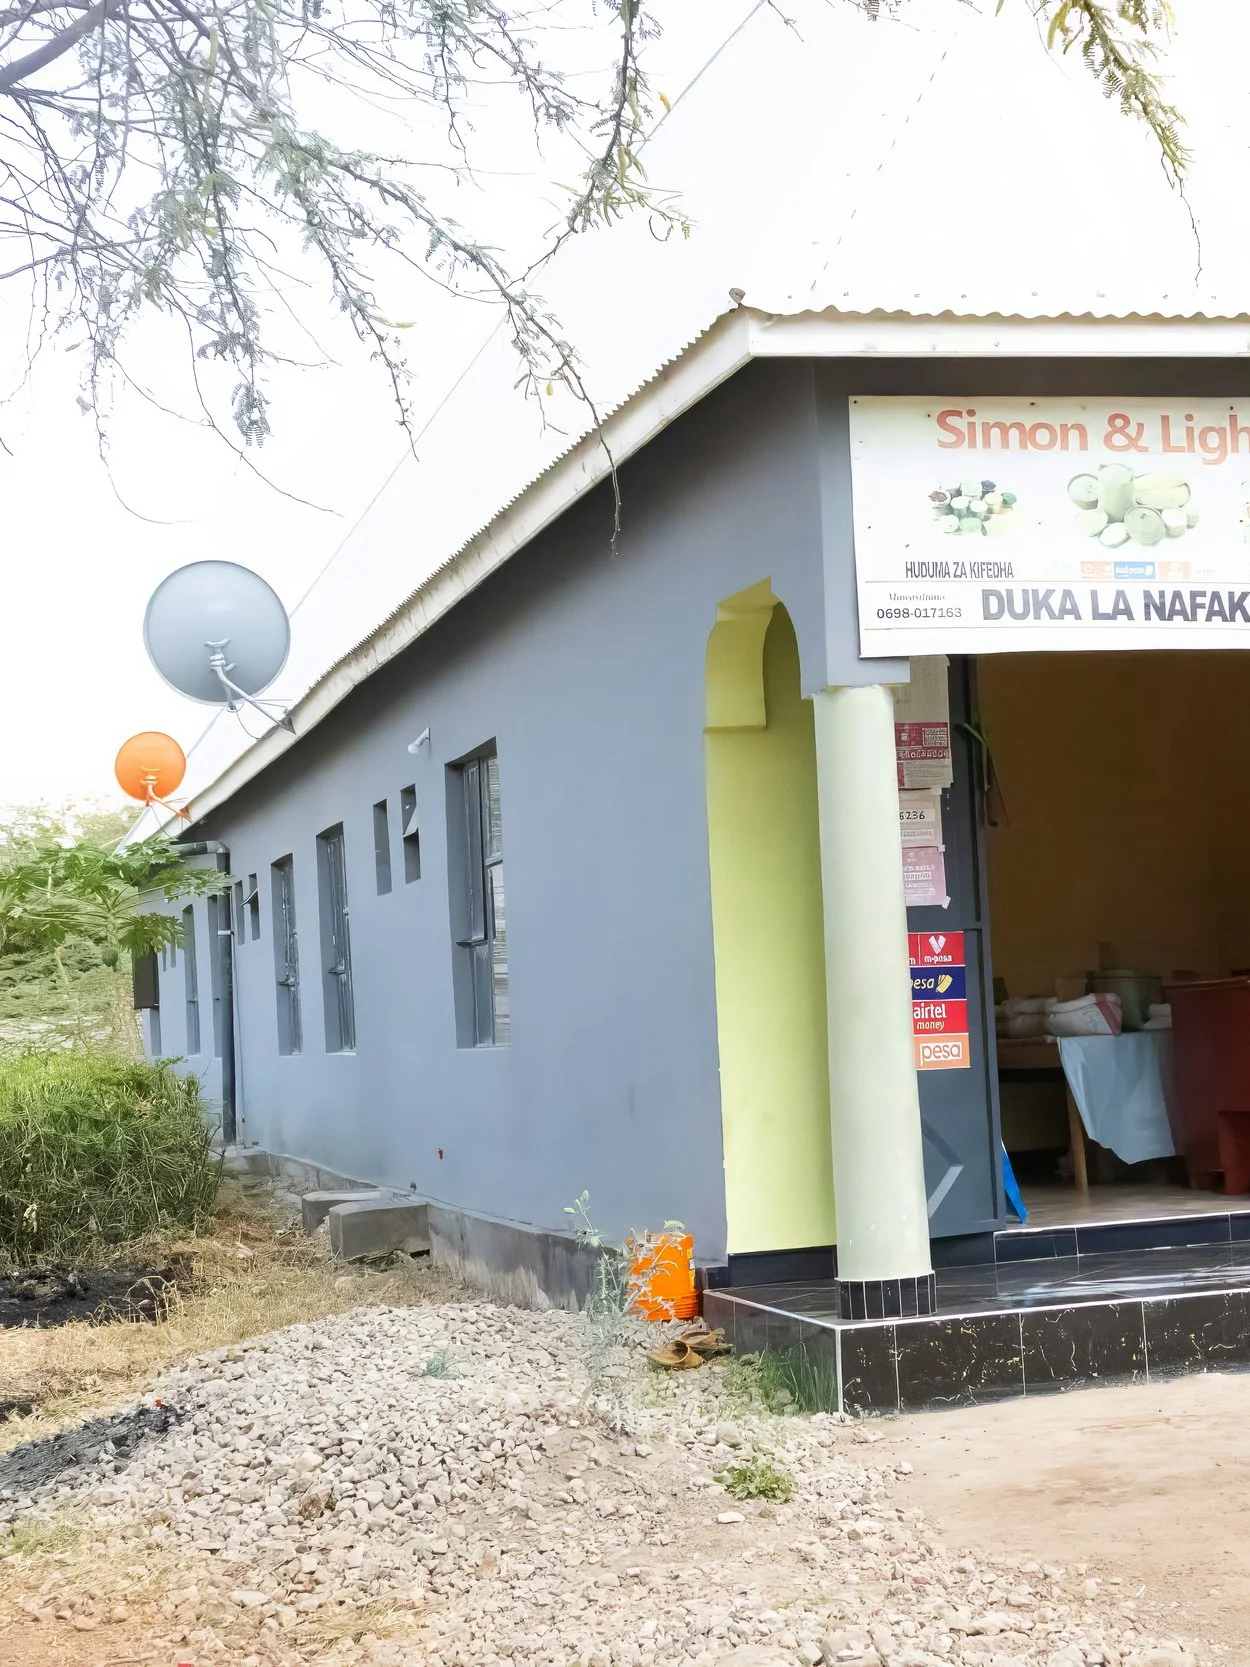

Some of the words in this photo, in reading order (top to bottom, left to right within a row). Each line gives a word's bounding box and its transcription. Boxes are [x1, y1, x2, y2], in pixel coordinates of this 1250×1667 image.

[936, 408, 1089, 452] Simon
[1103, 413, 1149, 452] &
[905, 561, 951, 579] HUDUMA
[953, 561, 968, 579] ZA
[969, 561, 1015, 579] KIFEDHA
[876, 607, 963, 619] 0698-017163
[981, 588, 1083, 621] DUKA
[1090, 588, 1135, 622] LA
[913, 1003, 947, 1019] airtel
[917, 1020, 945, 1031] money
[920, 1042, 962, 1067] pesa
